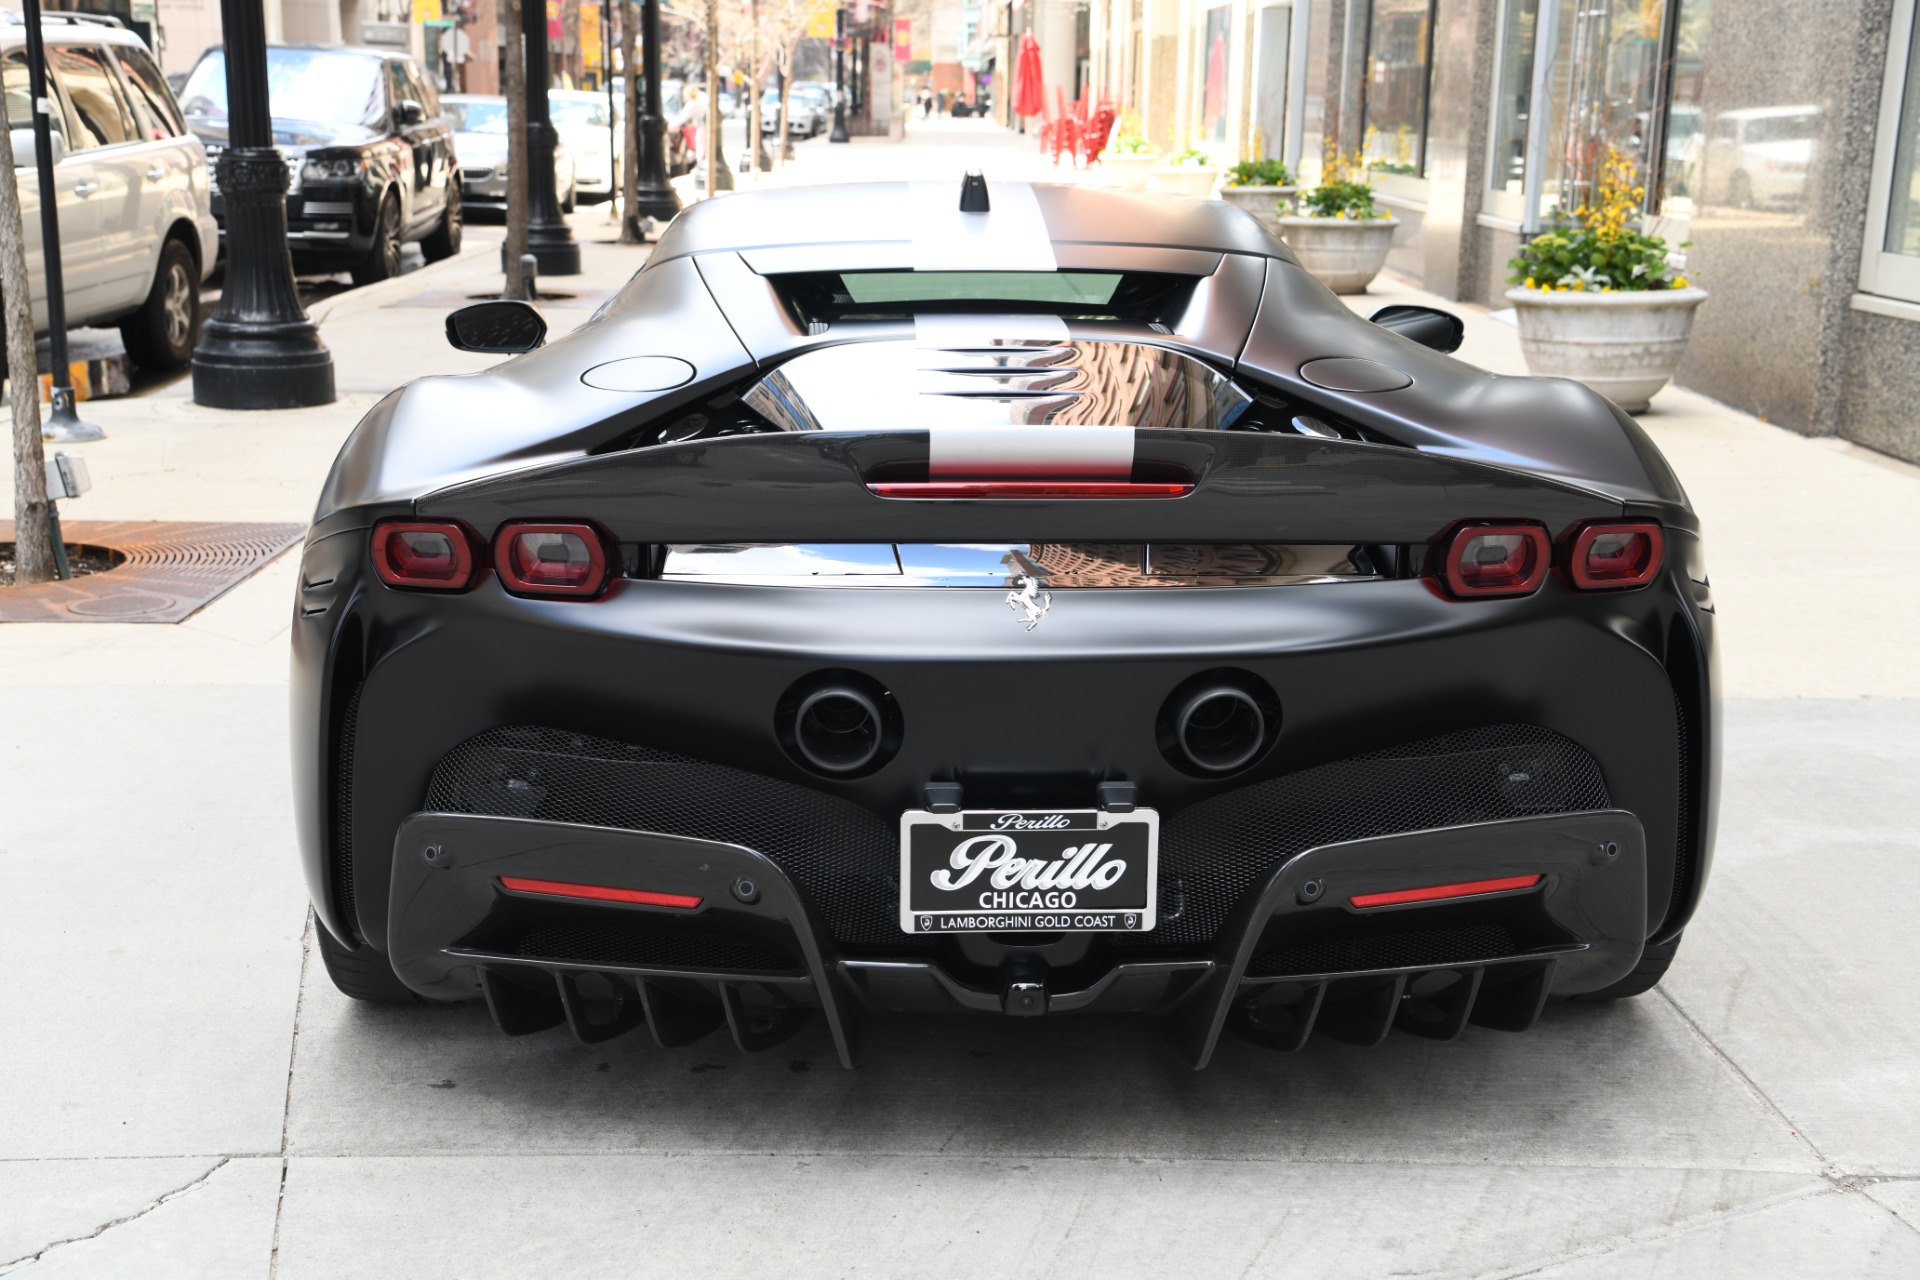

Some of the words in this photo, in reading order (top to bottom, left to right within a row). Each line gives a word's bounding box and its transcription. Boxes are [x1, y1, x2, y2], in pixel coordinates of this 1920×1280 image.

[990, 813, 1070, 830] Perillo
[930, 834, 1127, 890] Perillo
[978, 891, 1077, 909] CHICAGO
[940, 916, 1031, 929] LAMBORGHINI
[1034, 916, 1071, 928] GOLD
[1074, 915, 1116, 927] COAST
